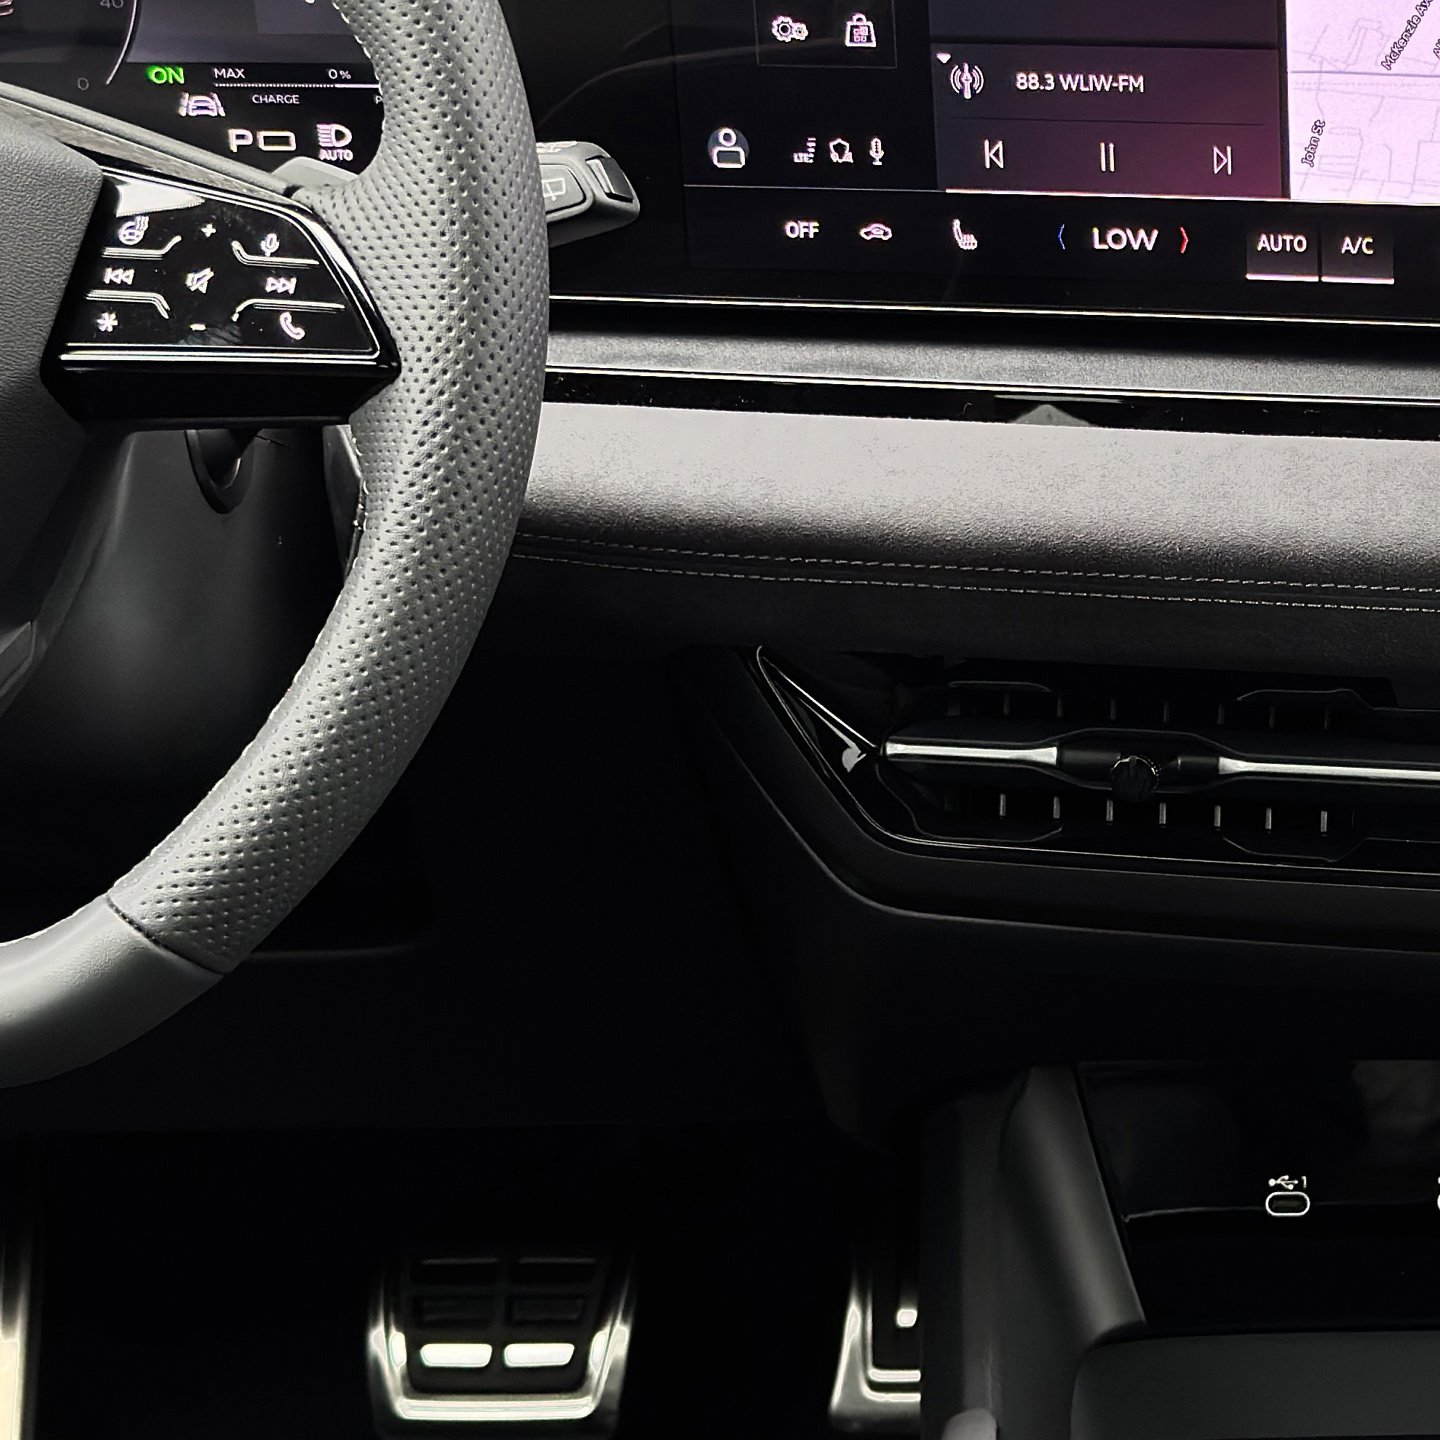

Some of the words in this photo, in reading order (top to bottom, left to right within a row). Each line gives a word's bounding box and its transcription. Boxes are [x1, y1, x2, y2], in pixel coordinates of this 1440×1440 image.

[1381, 13, 1421, 71] McKenzie
[147, 65, 185, 85] ON
[214, 67, 246, 79] MAX
[1015, 72, 1055, 91] 88.3
[1058, 73, 1144, 93] WLIW-FM
[77, 77, 89, 91] 0
[251, 94, 300, 105] CHARGE
[1310, 119, 1326, 136] St
[228, 128, 254, 153] P
[318, 149, 354, 162] AUTO
[1301, 136, 1320, 168] John
[784, 221, 820, 239] OFF
[1092, 227, 1159, 251] LOW
[1257, 234, 1307, 253] AUTO
[1341, 236, 1374, 255] A/C
